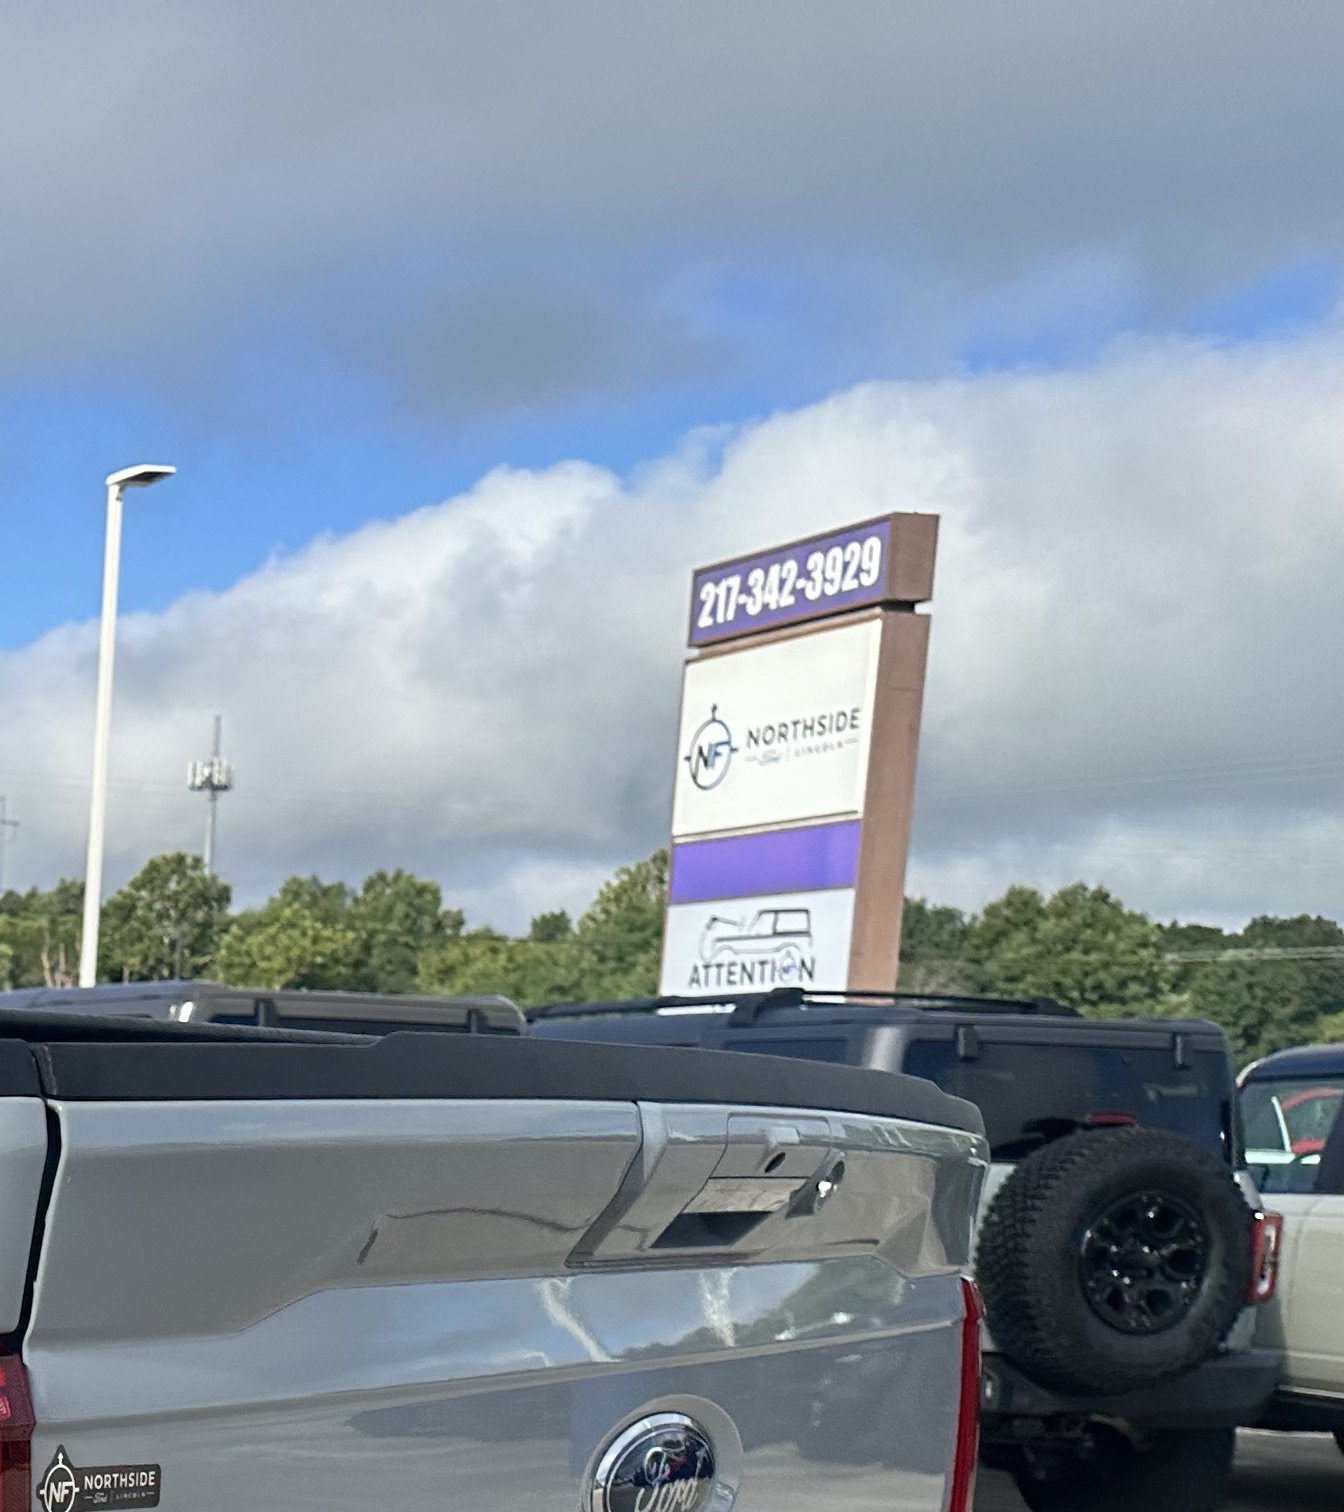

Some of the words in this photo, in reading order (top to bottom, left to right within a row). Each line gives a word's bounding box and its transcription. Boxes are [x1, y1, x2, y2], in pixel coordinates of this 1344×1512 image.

[697, 536, 882, 629] 217-342-3929
[746, 707, 861, 749] NORTHSIDE
[48, 1480, 74, 1508] NF
[84, 1471, 156, 1490] NORTHSIDE
